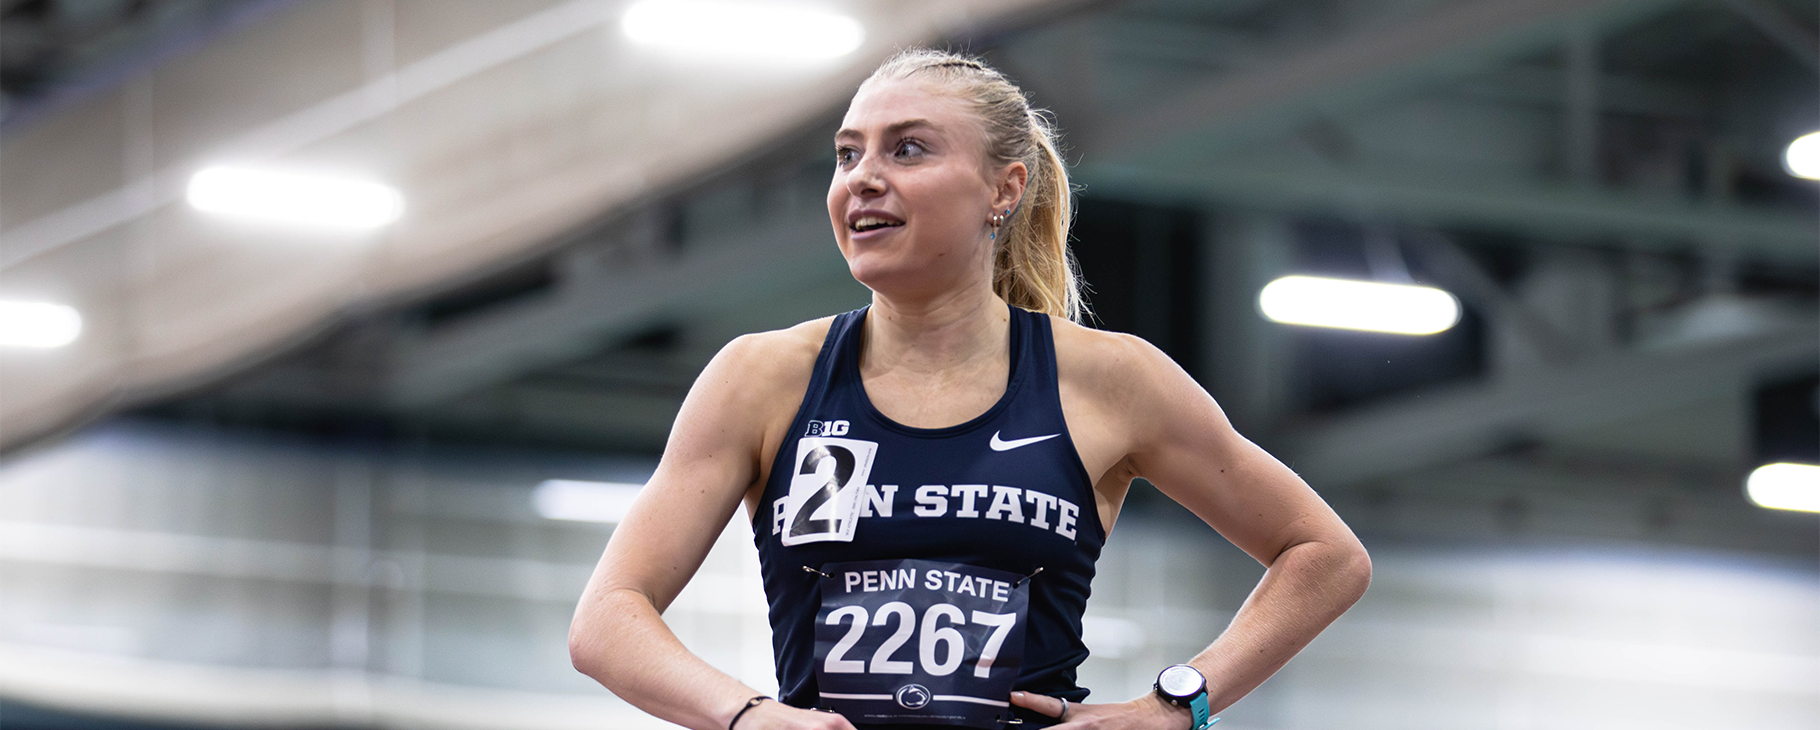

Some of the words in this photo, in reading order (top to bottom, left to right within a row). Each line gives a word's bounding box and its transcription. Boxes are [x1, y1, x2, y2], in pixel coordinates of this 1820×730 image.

[772, 485, 898, 536] PN
[913, 484, 1080, 542] STATE
[789, 445, 856, 538] 2
[845, 568, 916, 593] PENN
[924, 571, 1010, 602] STATE
[823, 601, 1017, 679] 2267
